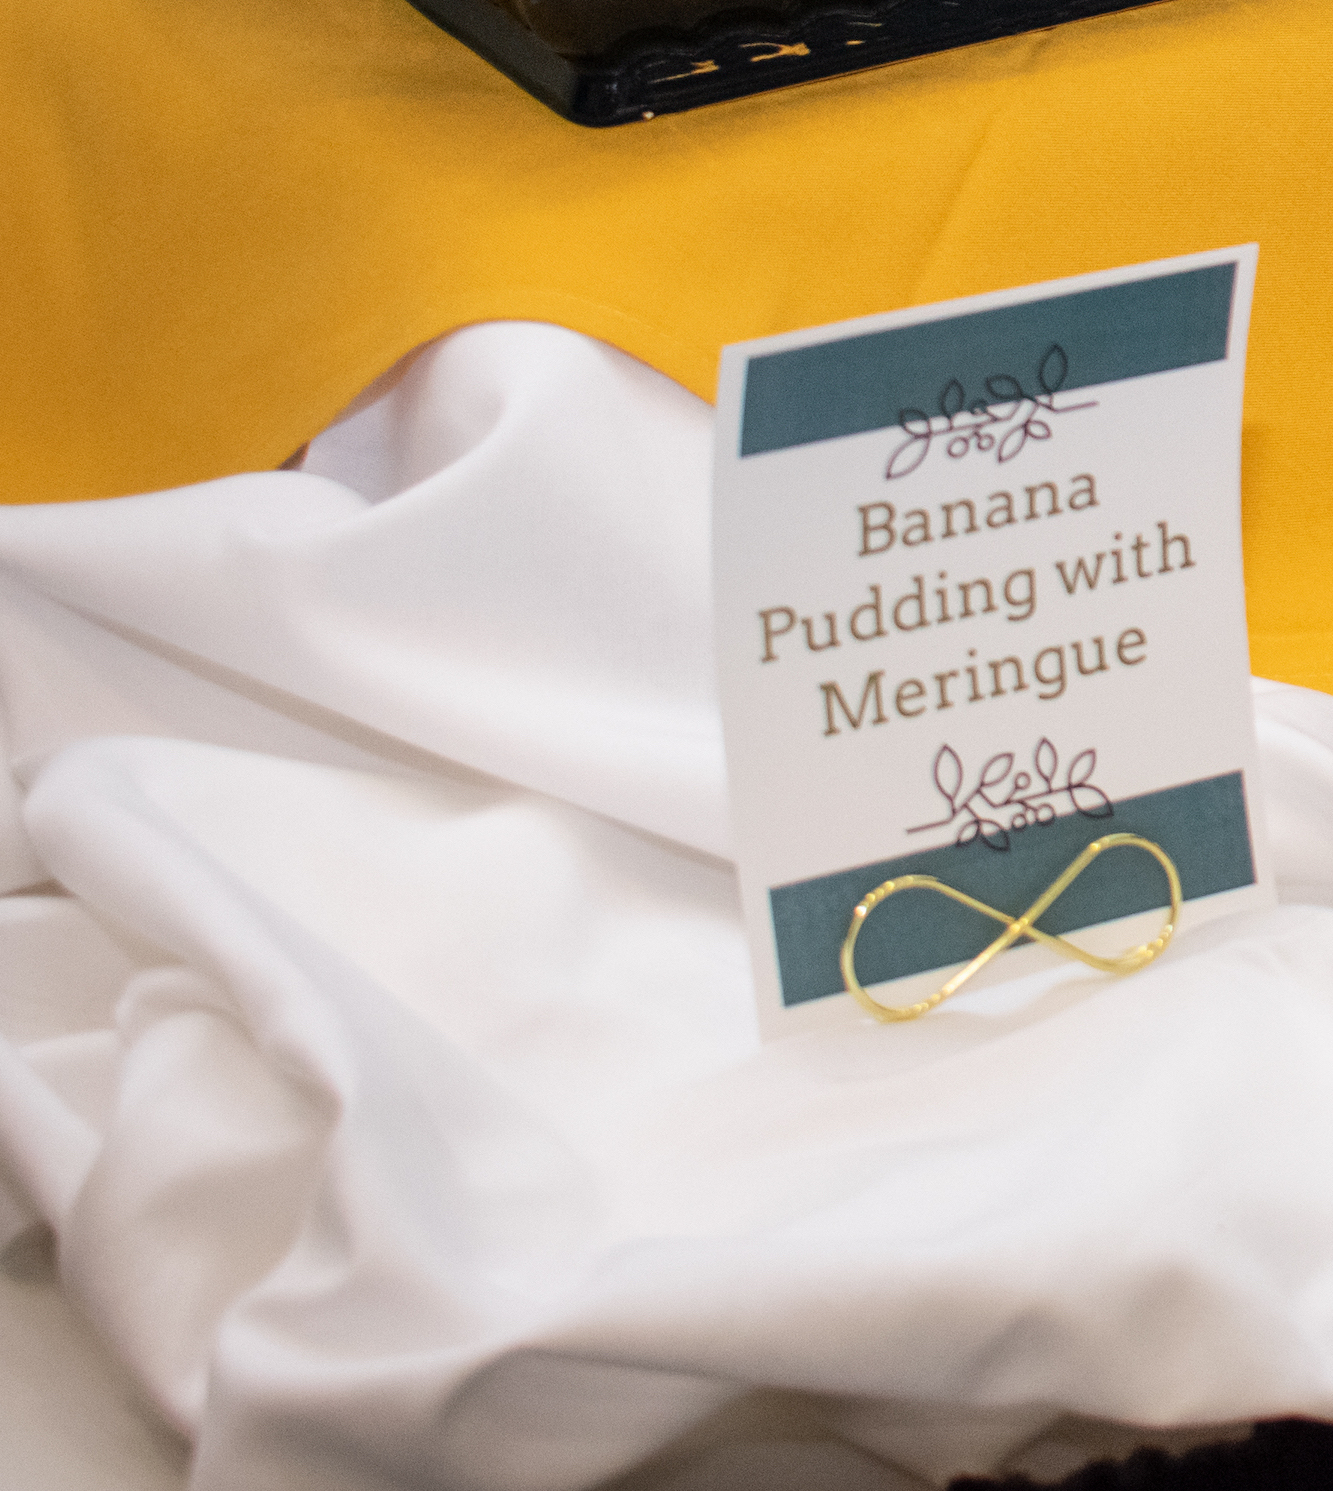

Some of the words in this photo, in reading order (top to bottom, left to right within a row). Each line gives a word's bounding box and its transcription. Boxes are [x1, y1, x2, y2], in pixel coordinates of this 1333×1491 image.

[857, 472, 1100, 557] Banana
[758, 567, 1037, 663] Pudding
[1056, 521, 1197, 595] with
[819, 626, 1148, 737] Meringue
